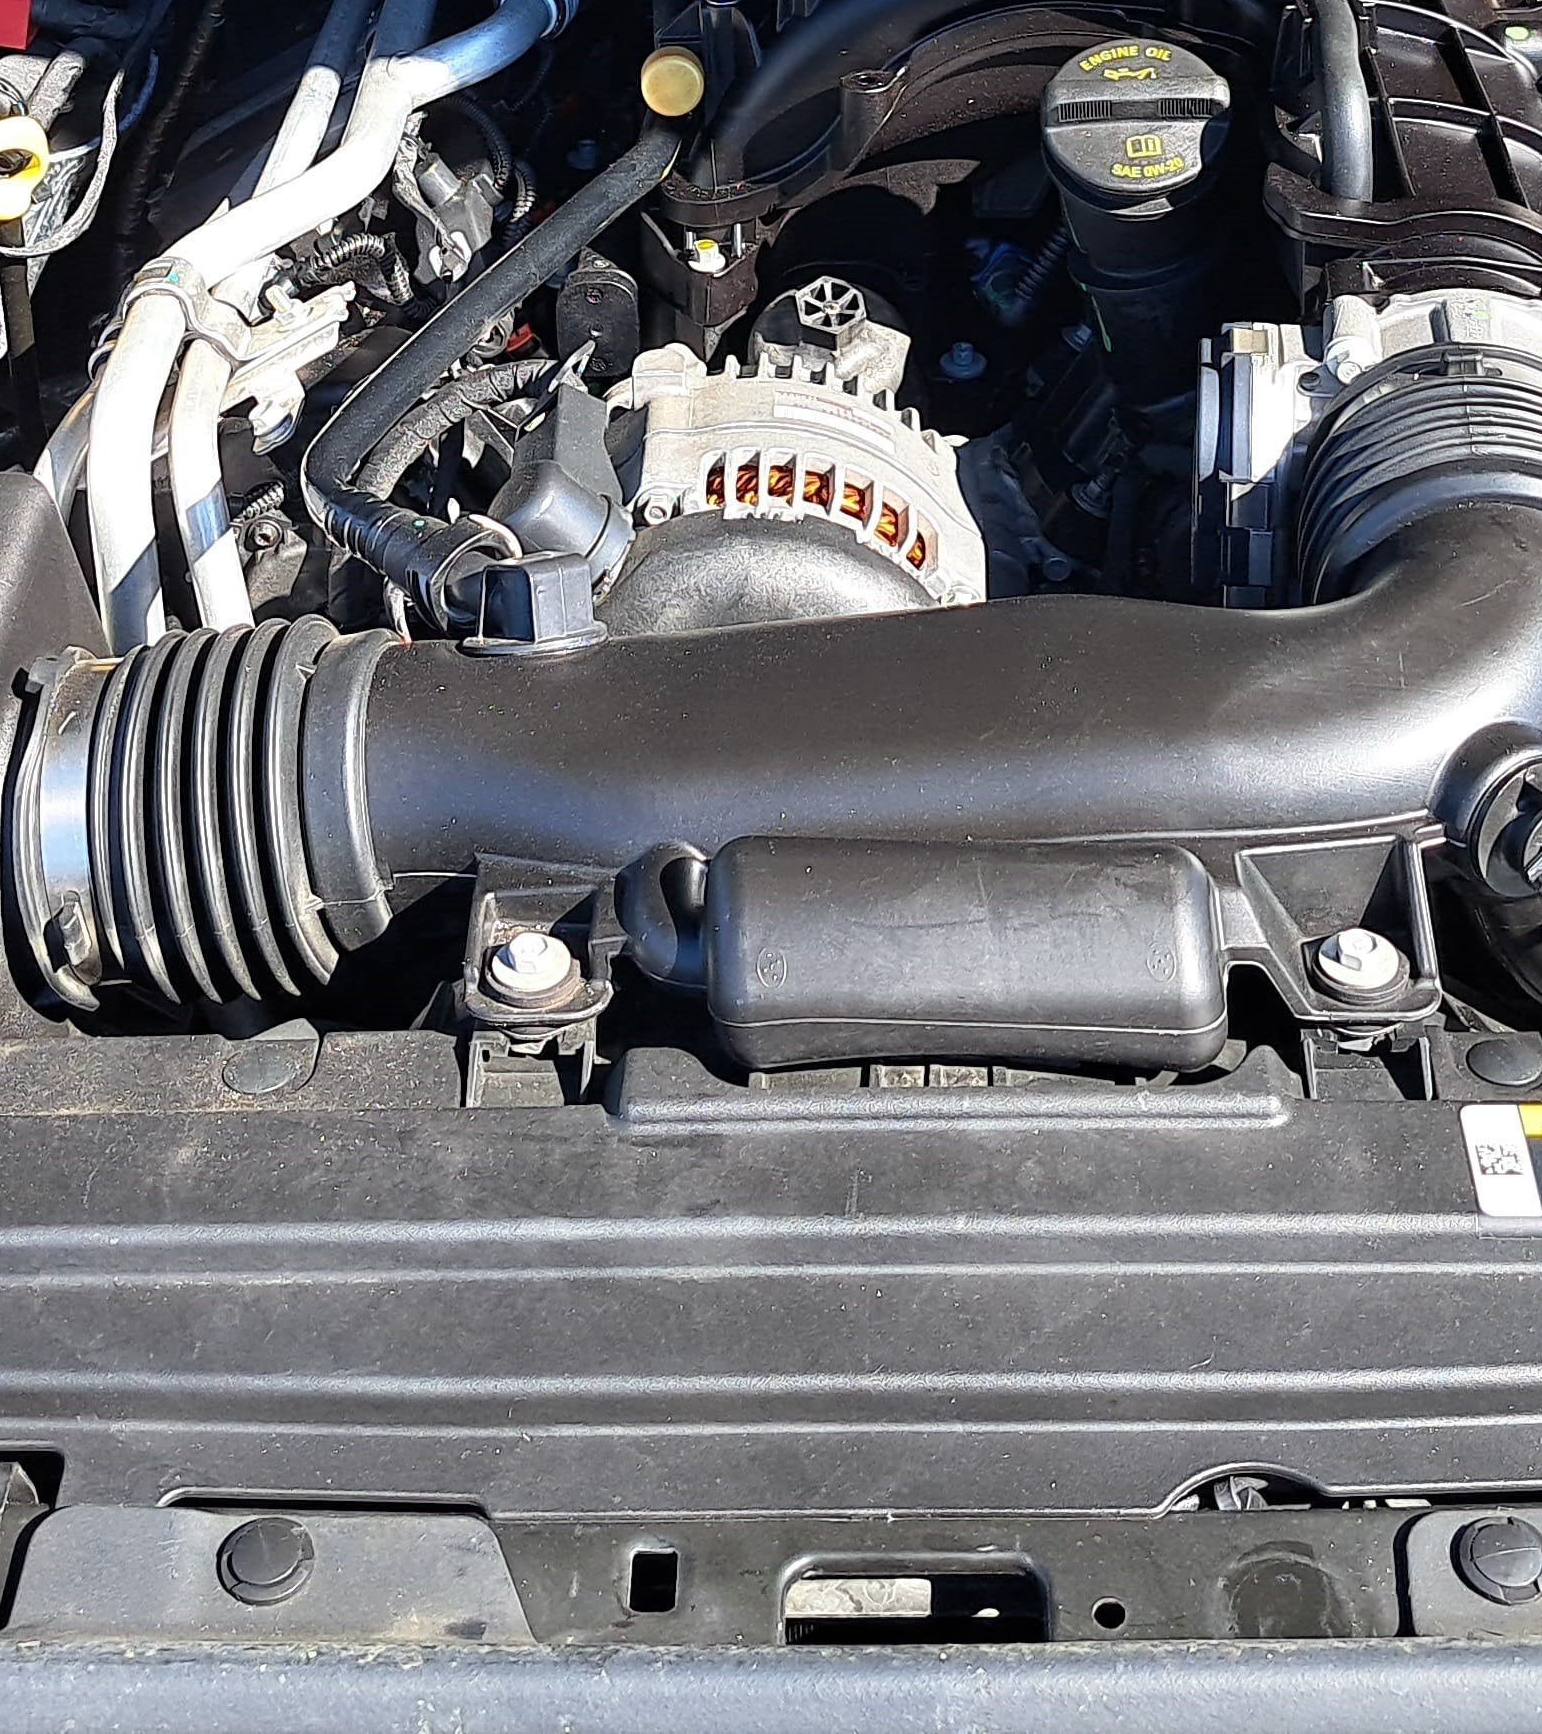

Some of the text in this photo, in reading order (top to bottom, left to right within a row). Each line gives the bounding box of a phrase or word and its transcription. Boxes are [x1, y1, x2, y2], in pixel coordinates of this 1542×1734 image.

[1079, 44, 1173, 72] ENGINE OIL
[1110, 156, 1185, 178] SAE 0W-20
